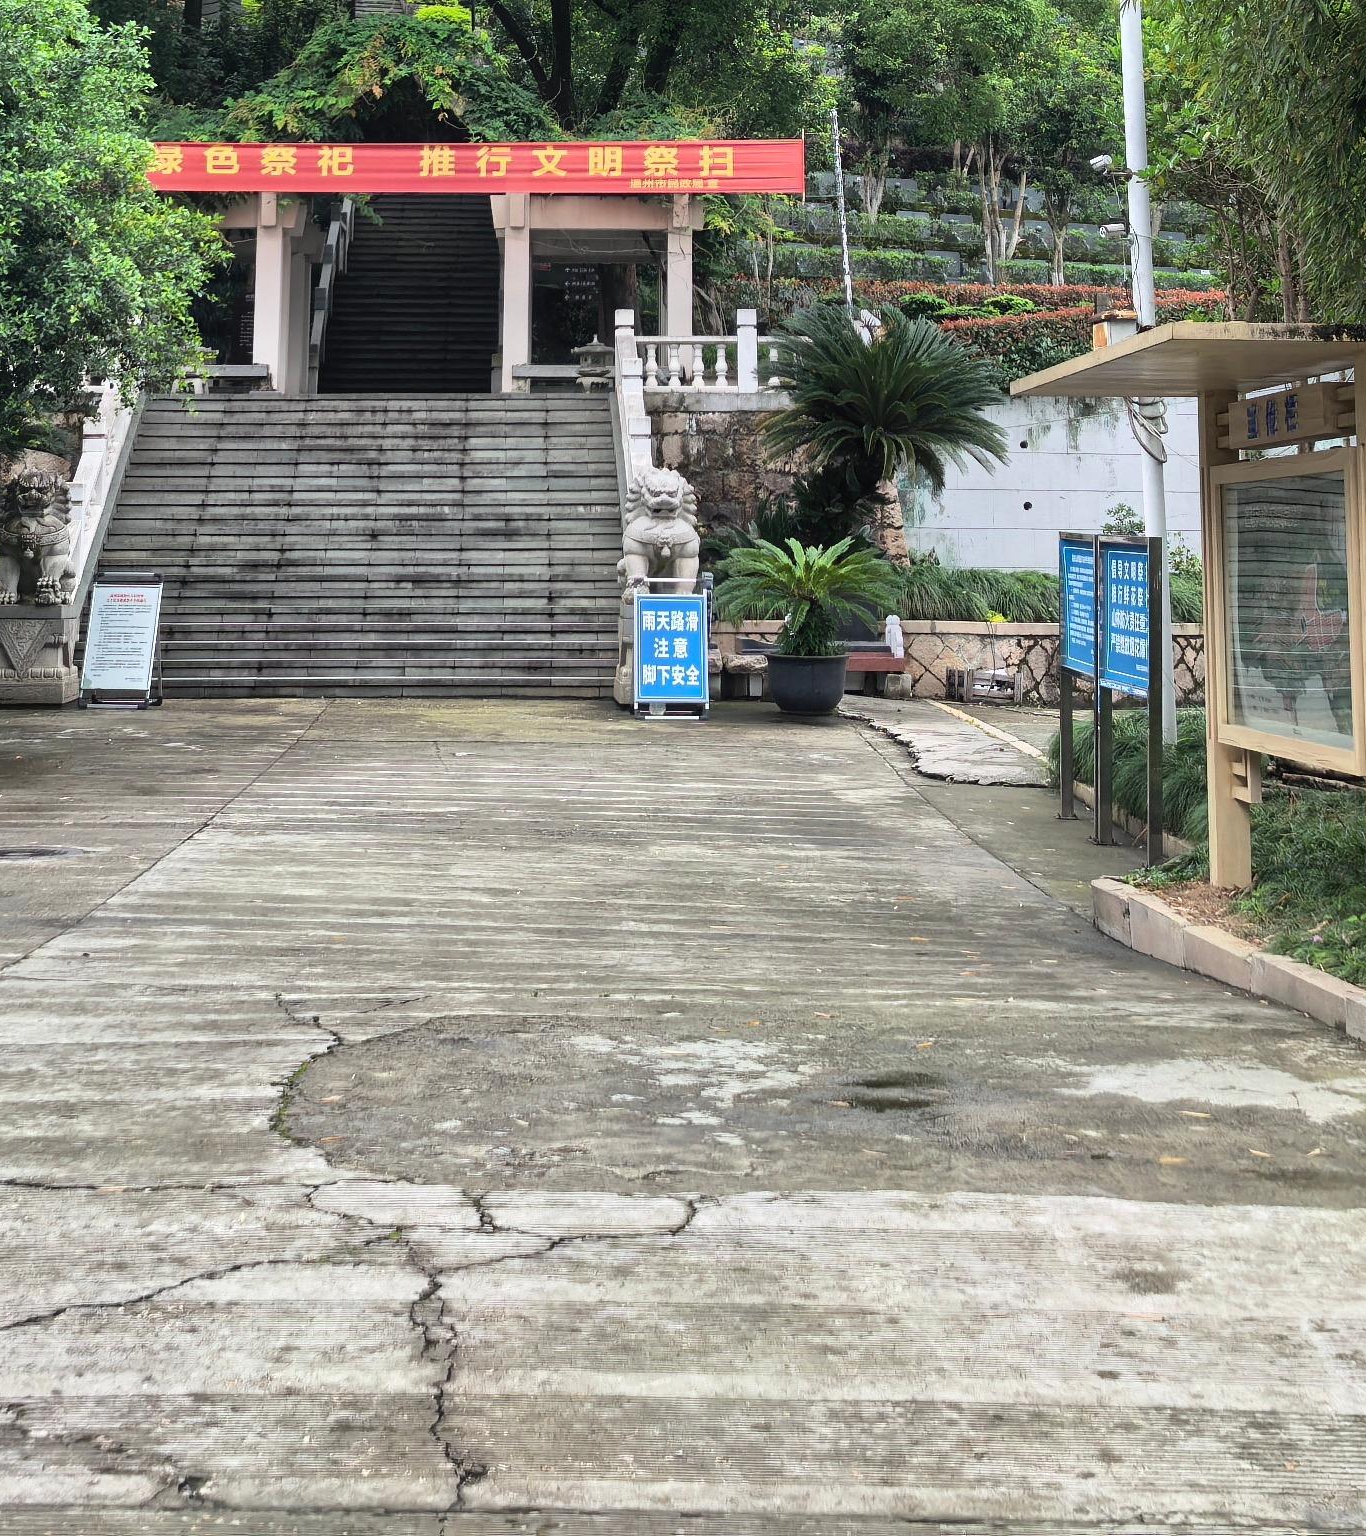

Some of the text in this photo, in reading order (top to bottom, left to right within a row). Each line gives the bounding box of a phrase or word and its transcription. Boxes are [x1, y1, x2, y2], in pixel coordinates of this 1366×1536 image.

[152, 145, 735, 177] 绿色祭祀 推行文明祭扫
[1111, 559, 1148, 583] 倡导文明祭
[1111, 583, 1148, 608] 推行鲜花祭
[642, 610, 699, 632] 雨天路滑
[1111, 608, 1148, 634] 山林防火责任重
[653, 637, 689, 659] 注意
[1110, 632, 1148, 660] 严禁燃放烟花爆
[642, 664, 700, 686] 脚下安全
